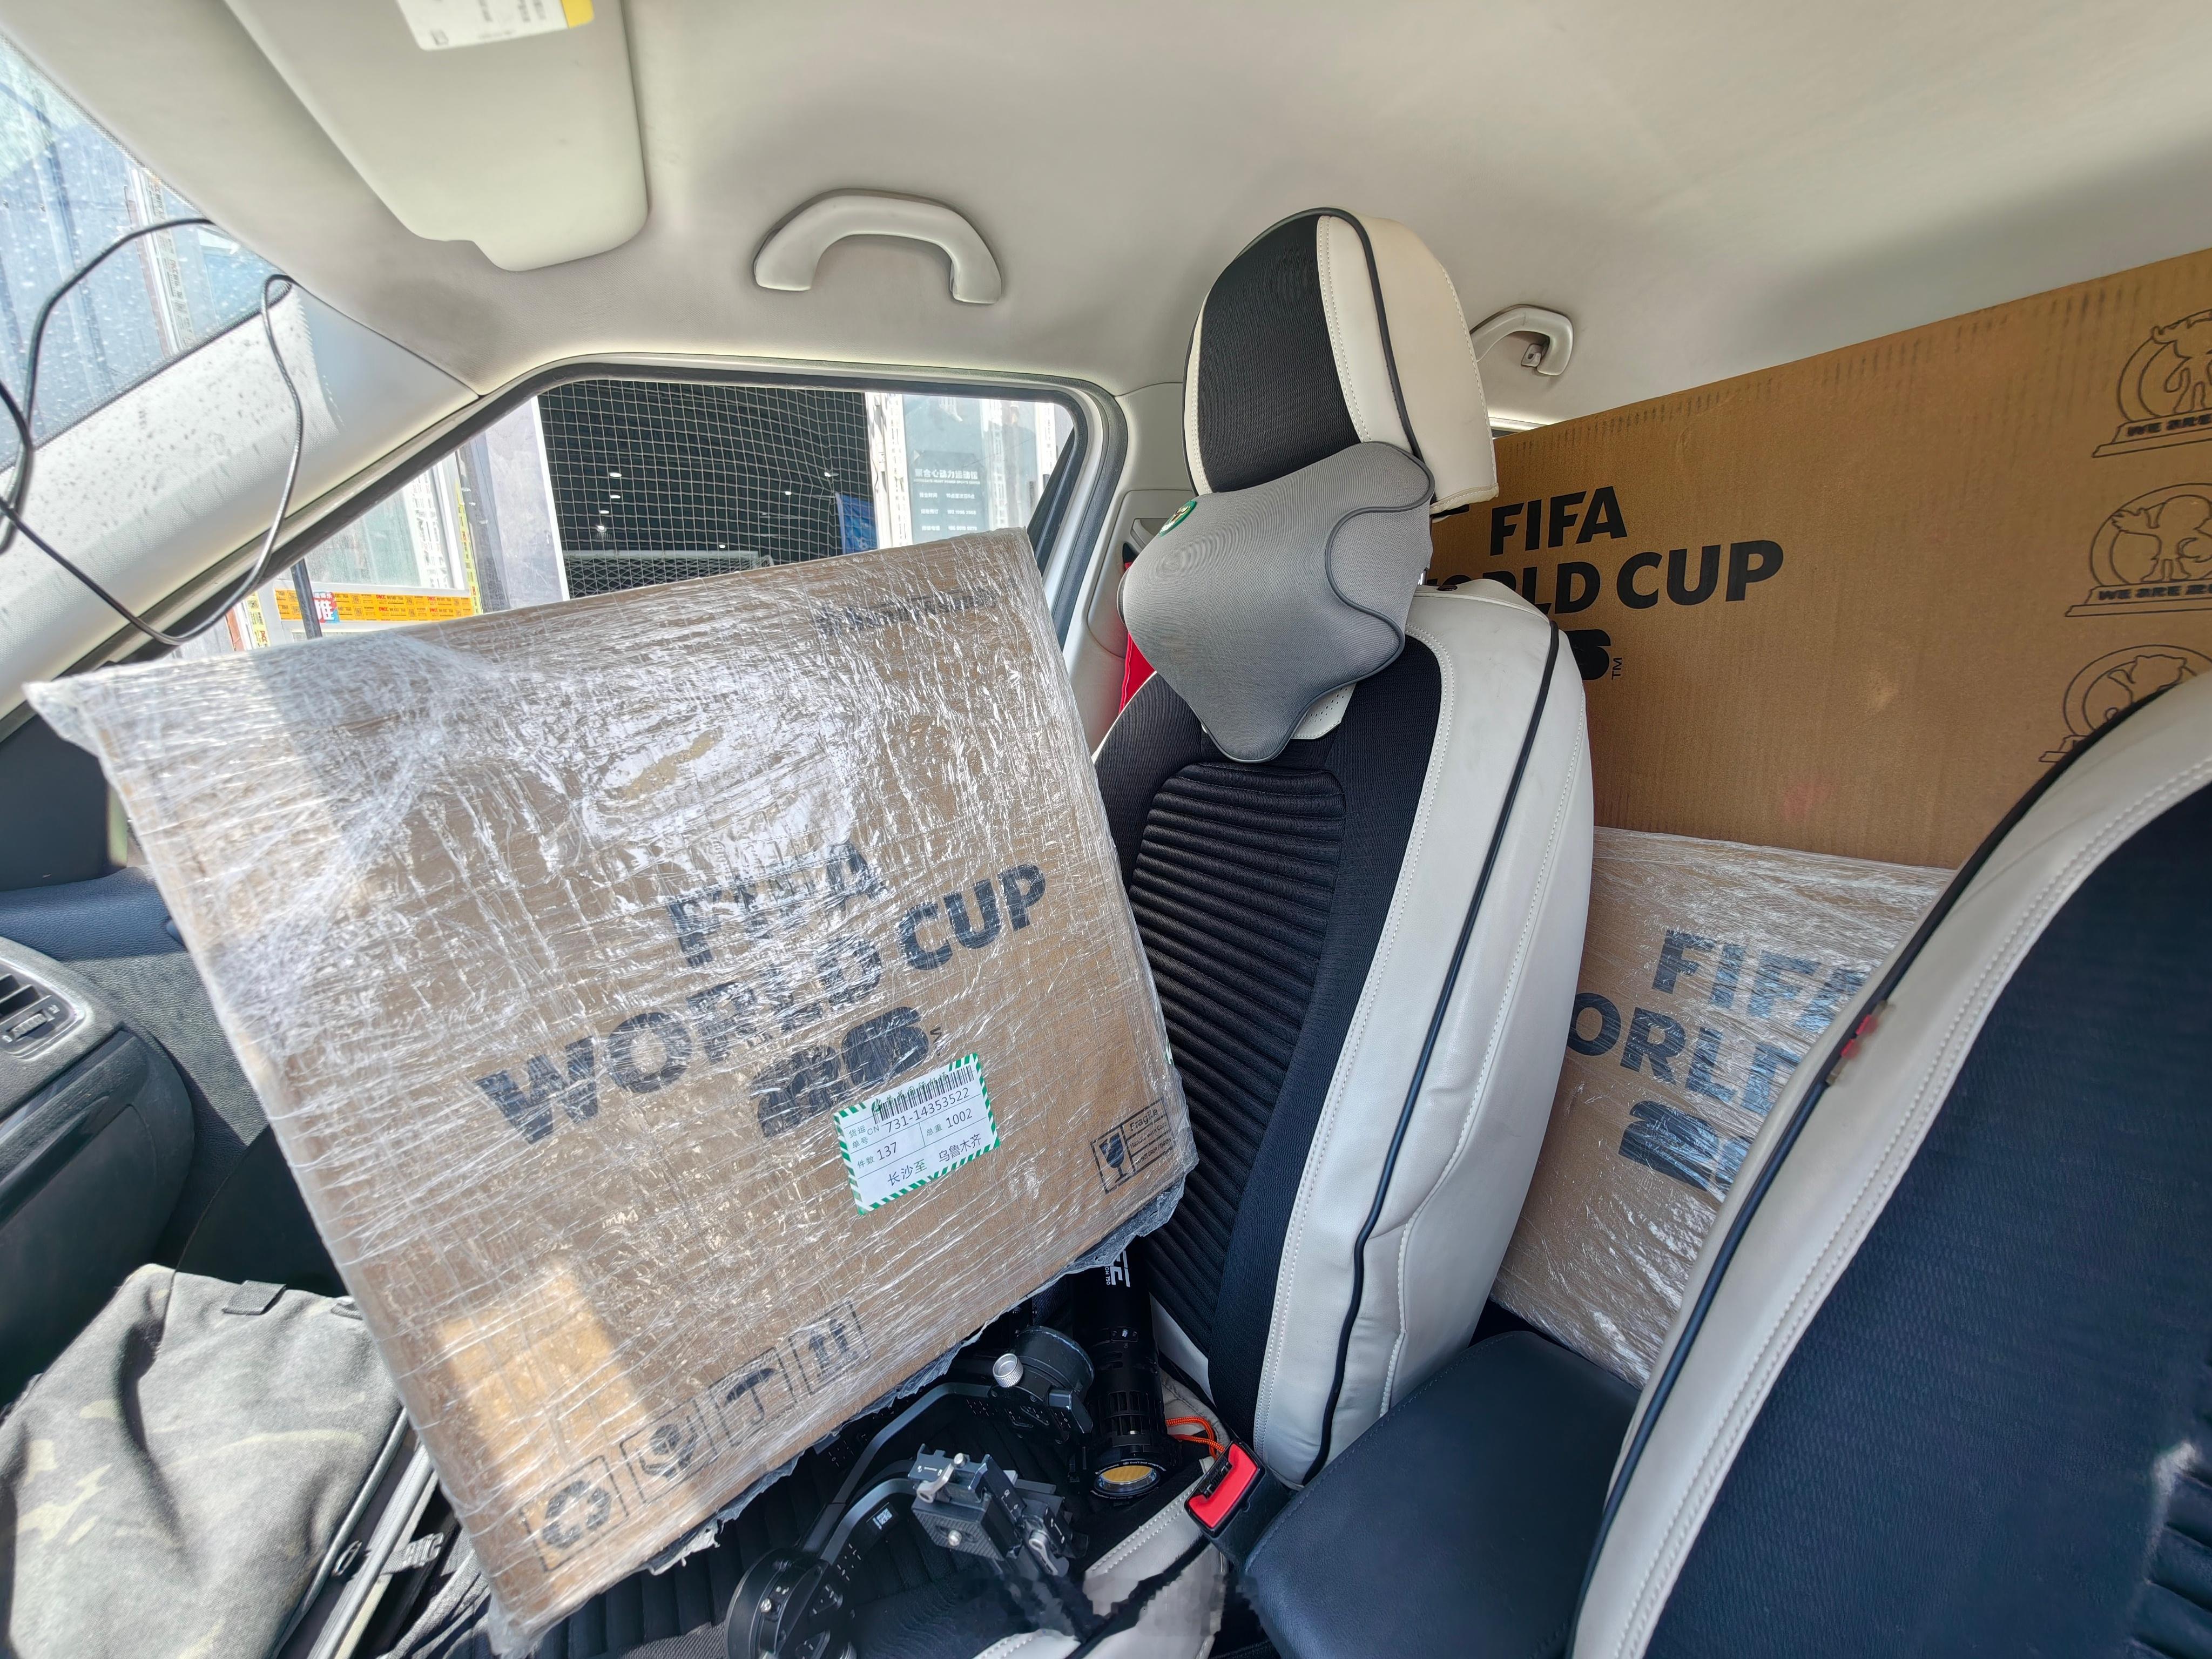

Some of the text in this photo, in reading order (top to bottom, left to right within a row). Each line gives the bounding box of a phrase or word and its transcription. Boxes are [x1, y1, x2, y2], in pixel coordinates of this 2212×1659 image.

[2127, 422, 2162, 436] WE
[1490, 486, 1627, 556] FIFA
[1617, 540, 1784, 609] CUP
[2099, 589, 2132, 600] WE
[2136, 585, 2181, 598] ARE
[1611, 657, 1622, 680] TM
[478, 865, 1046, 1144] WORLD CUP
[867, 1087, 970, 1135] CN 731-14353522
[926, 1108, 973, 1136] 总重 1002
[1129, 1109, 1158, 1131] Fragile
[849, 1125, 866, 1138] 货运
[852, 1136, 868, 1149] 单号
[857, 1142, 897, 1168] 件数 137
[887, 1134, 981, 1186] 长沙至 乌鲁木齐
[1148, 1147, 1158, 1157] DROP
